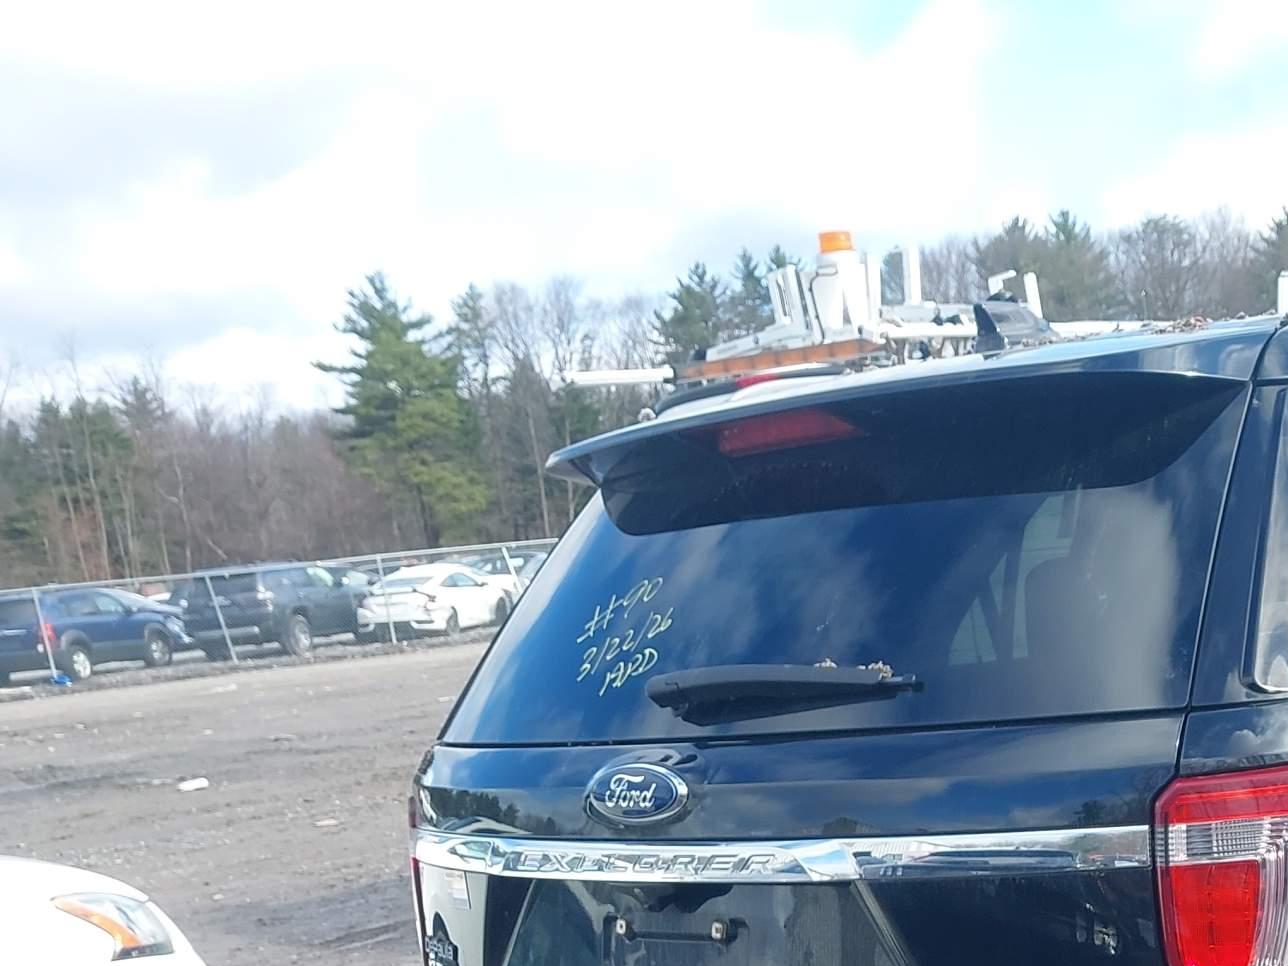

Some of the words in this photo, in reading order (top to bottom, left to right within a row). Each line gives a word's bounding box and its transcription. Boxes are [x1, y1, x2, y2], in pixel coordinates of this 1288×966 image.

[576, 607, 674, 682] 3/22/26
[605, 774, 656, 808] Ford
[516, 851, 776, 873] EXPLORER
